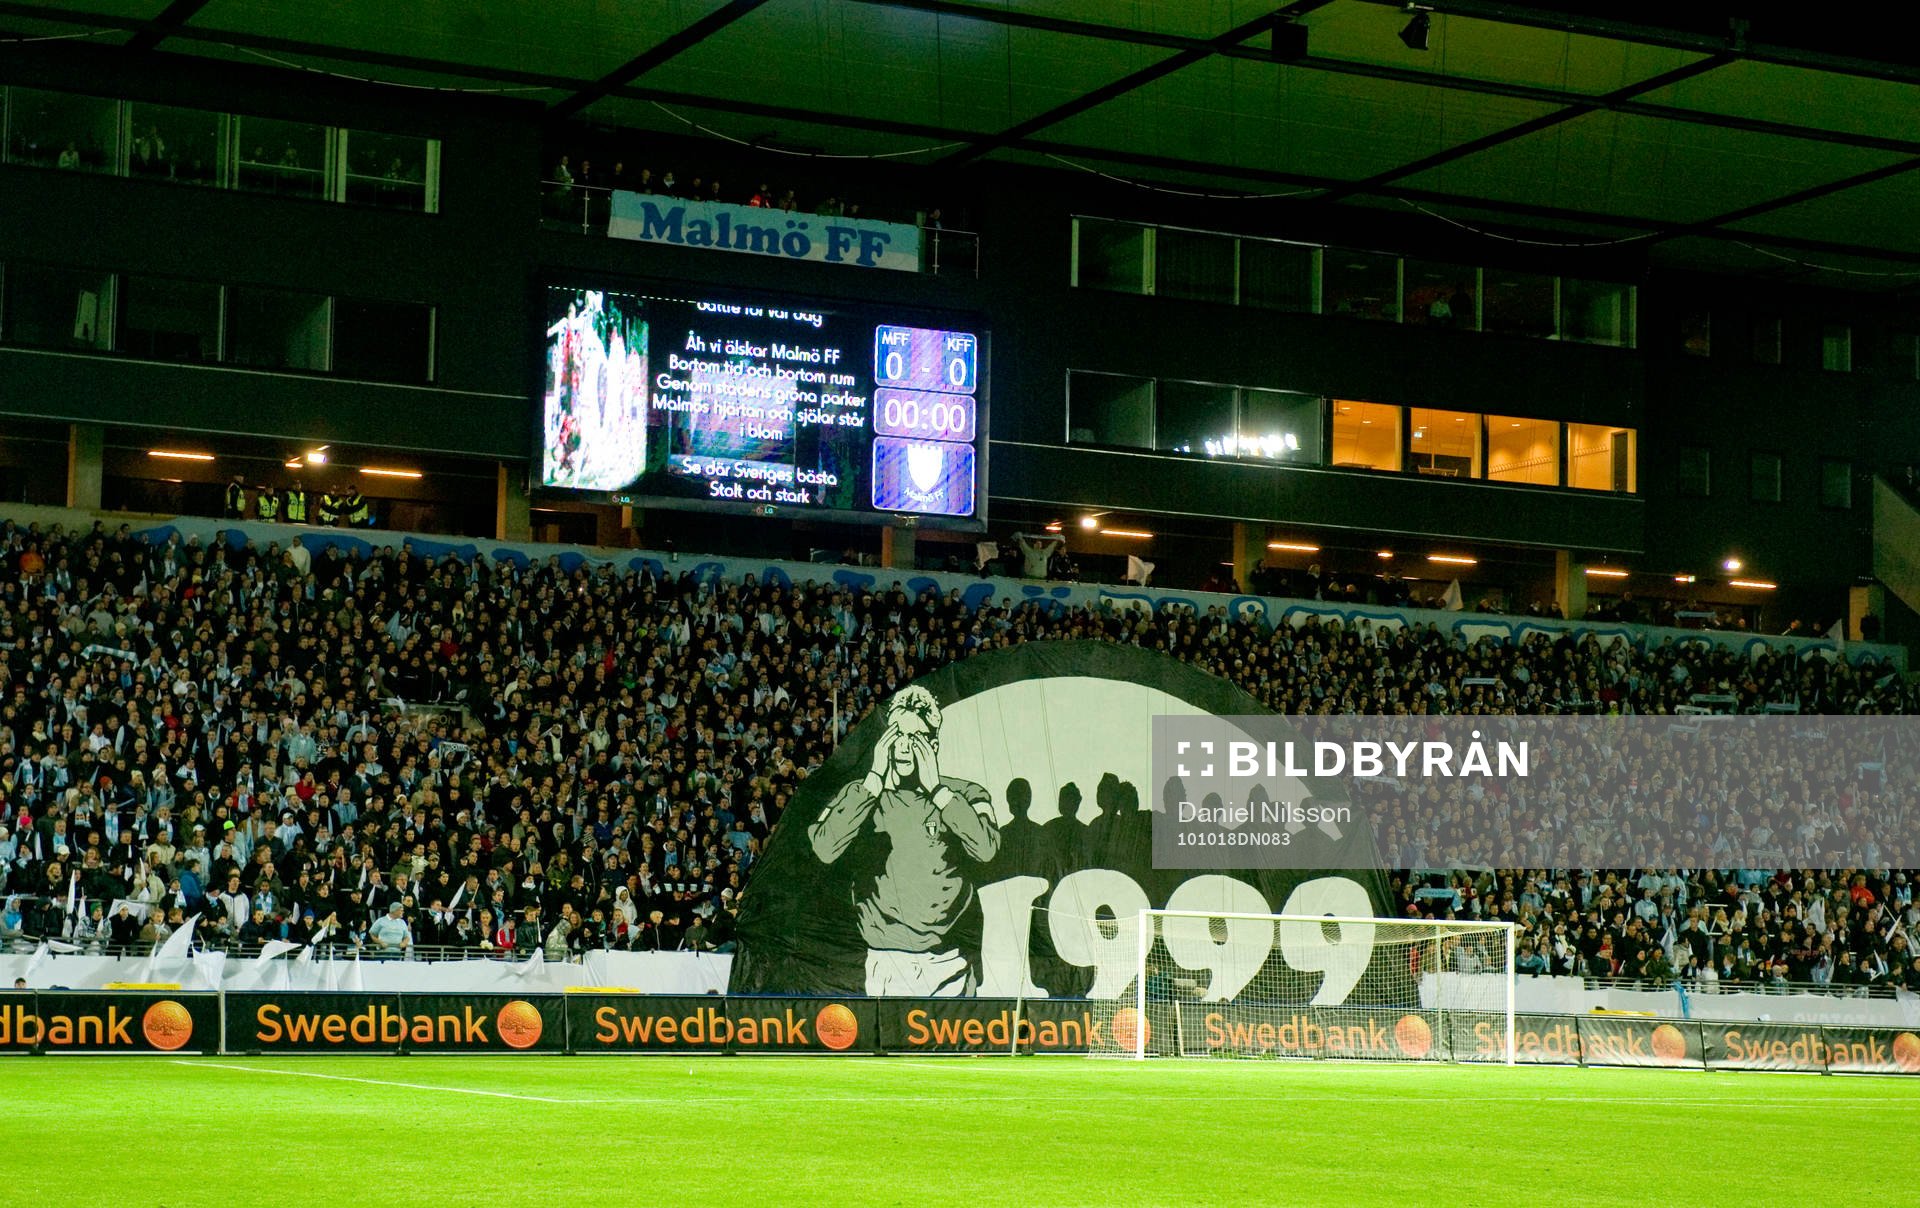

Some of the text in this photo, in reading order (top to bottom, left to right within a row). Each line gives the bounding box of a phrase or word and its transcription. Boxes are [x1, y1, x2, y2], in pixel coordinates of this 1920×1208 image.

[639, 201, 891, 267] Malmö FF
[686, 330, 840, 365] Åh vi älskar Malmö FF
[882, 331, 910, 346] MFF
[948, 337, 973, 352] KFF
[669, 354, 855, 386] Bortom tid och bortom rum
[886, 352, 903, 380] 0
[949, 358, 967, 386] 0
[656, 373, 866, 409] Genom stadens gröna parker
[652, 393, 864, 428] Malmös hjärtan och själar står
[884, 399, 966, 433] 00:00
[739, 423, 783, 441] i blom
[682, 457, 838, 486] Se där Sveriges bästa
[710, 481, 810, 504] Stolt och stark
[976, 868, 1376, 1006] 1999
[256, 1003, 489, 1044] Swedbank
[596, 1006, 809, 1045] Swedbank
[907, 1009, 1104, 1047] Swedbank
[1205, 1013, 1390, 1051] Swedbank
[1475, 1023, 1646, 1057] Swedbank
[1724, 1030, 1887, 1066] Swedbank
